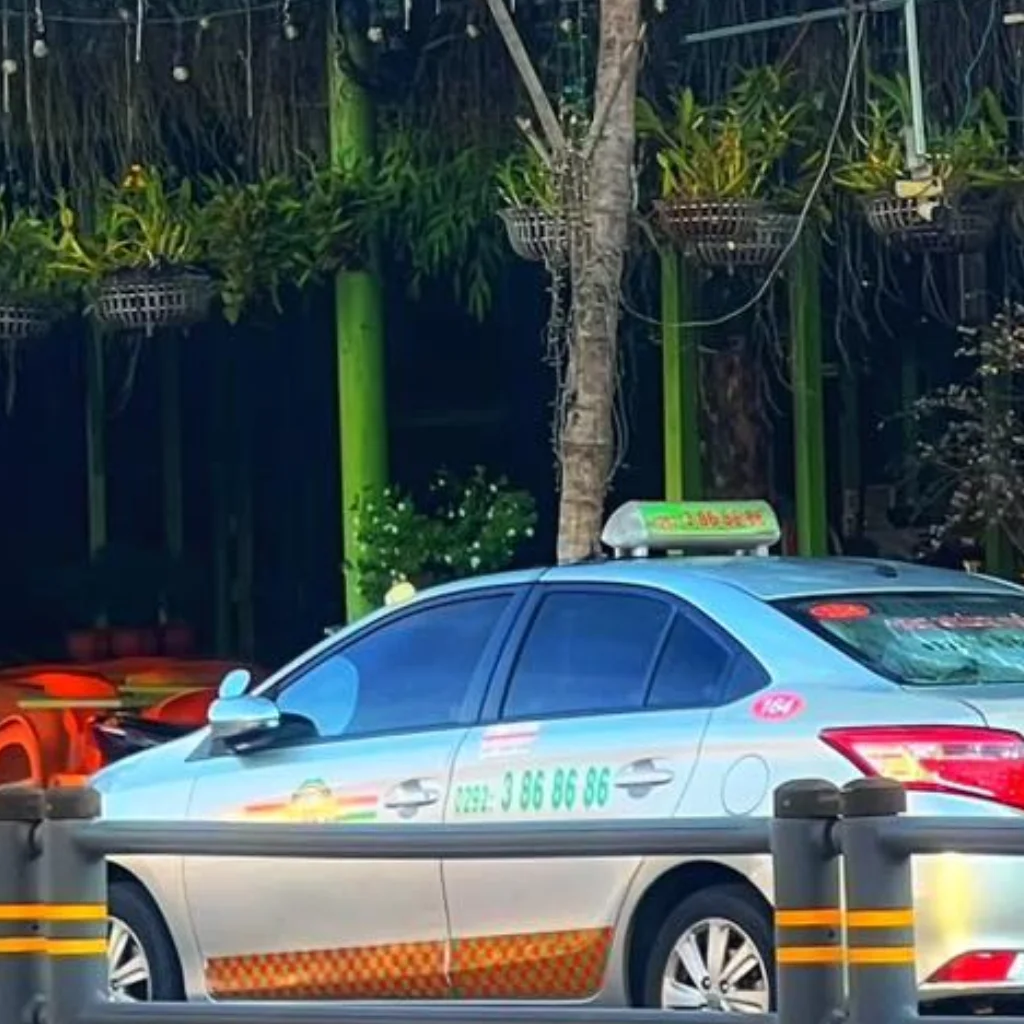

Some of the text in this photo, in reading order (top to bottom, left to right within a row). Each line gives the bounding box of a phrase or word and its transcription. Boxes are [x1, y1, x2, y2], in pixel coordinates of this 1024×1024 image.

[519, 769, 545, 811] 86
[551, 767, 577, 810] 86
[583, 765, 610, 807] 86
